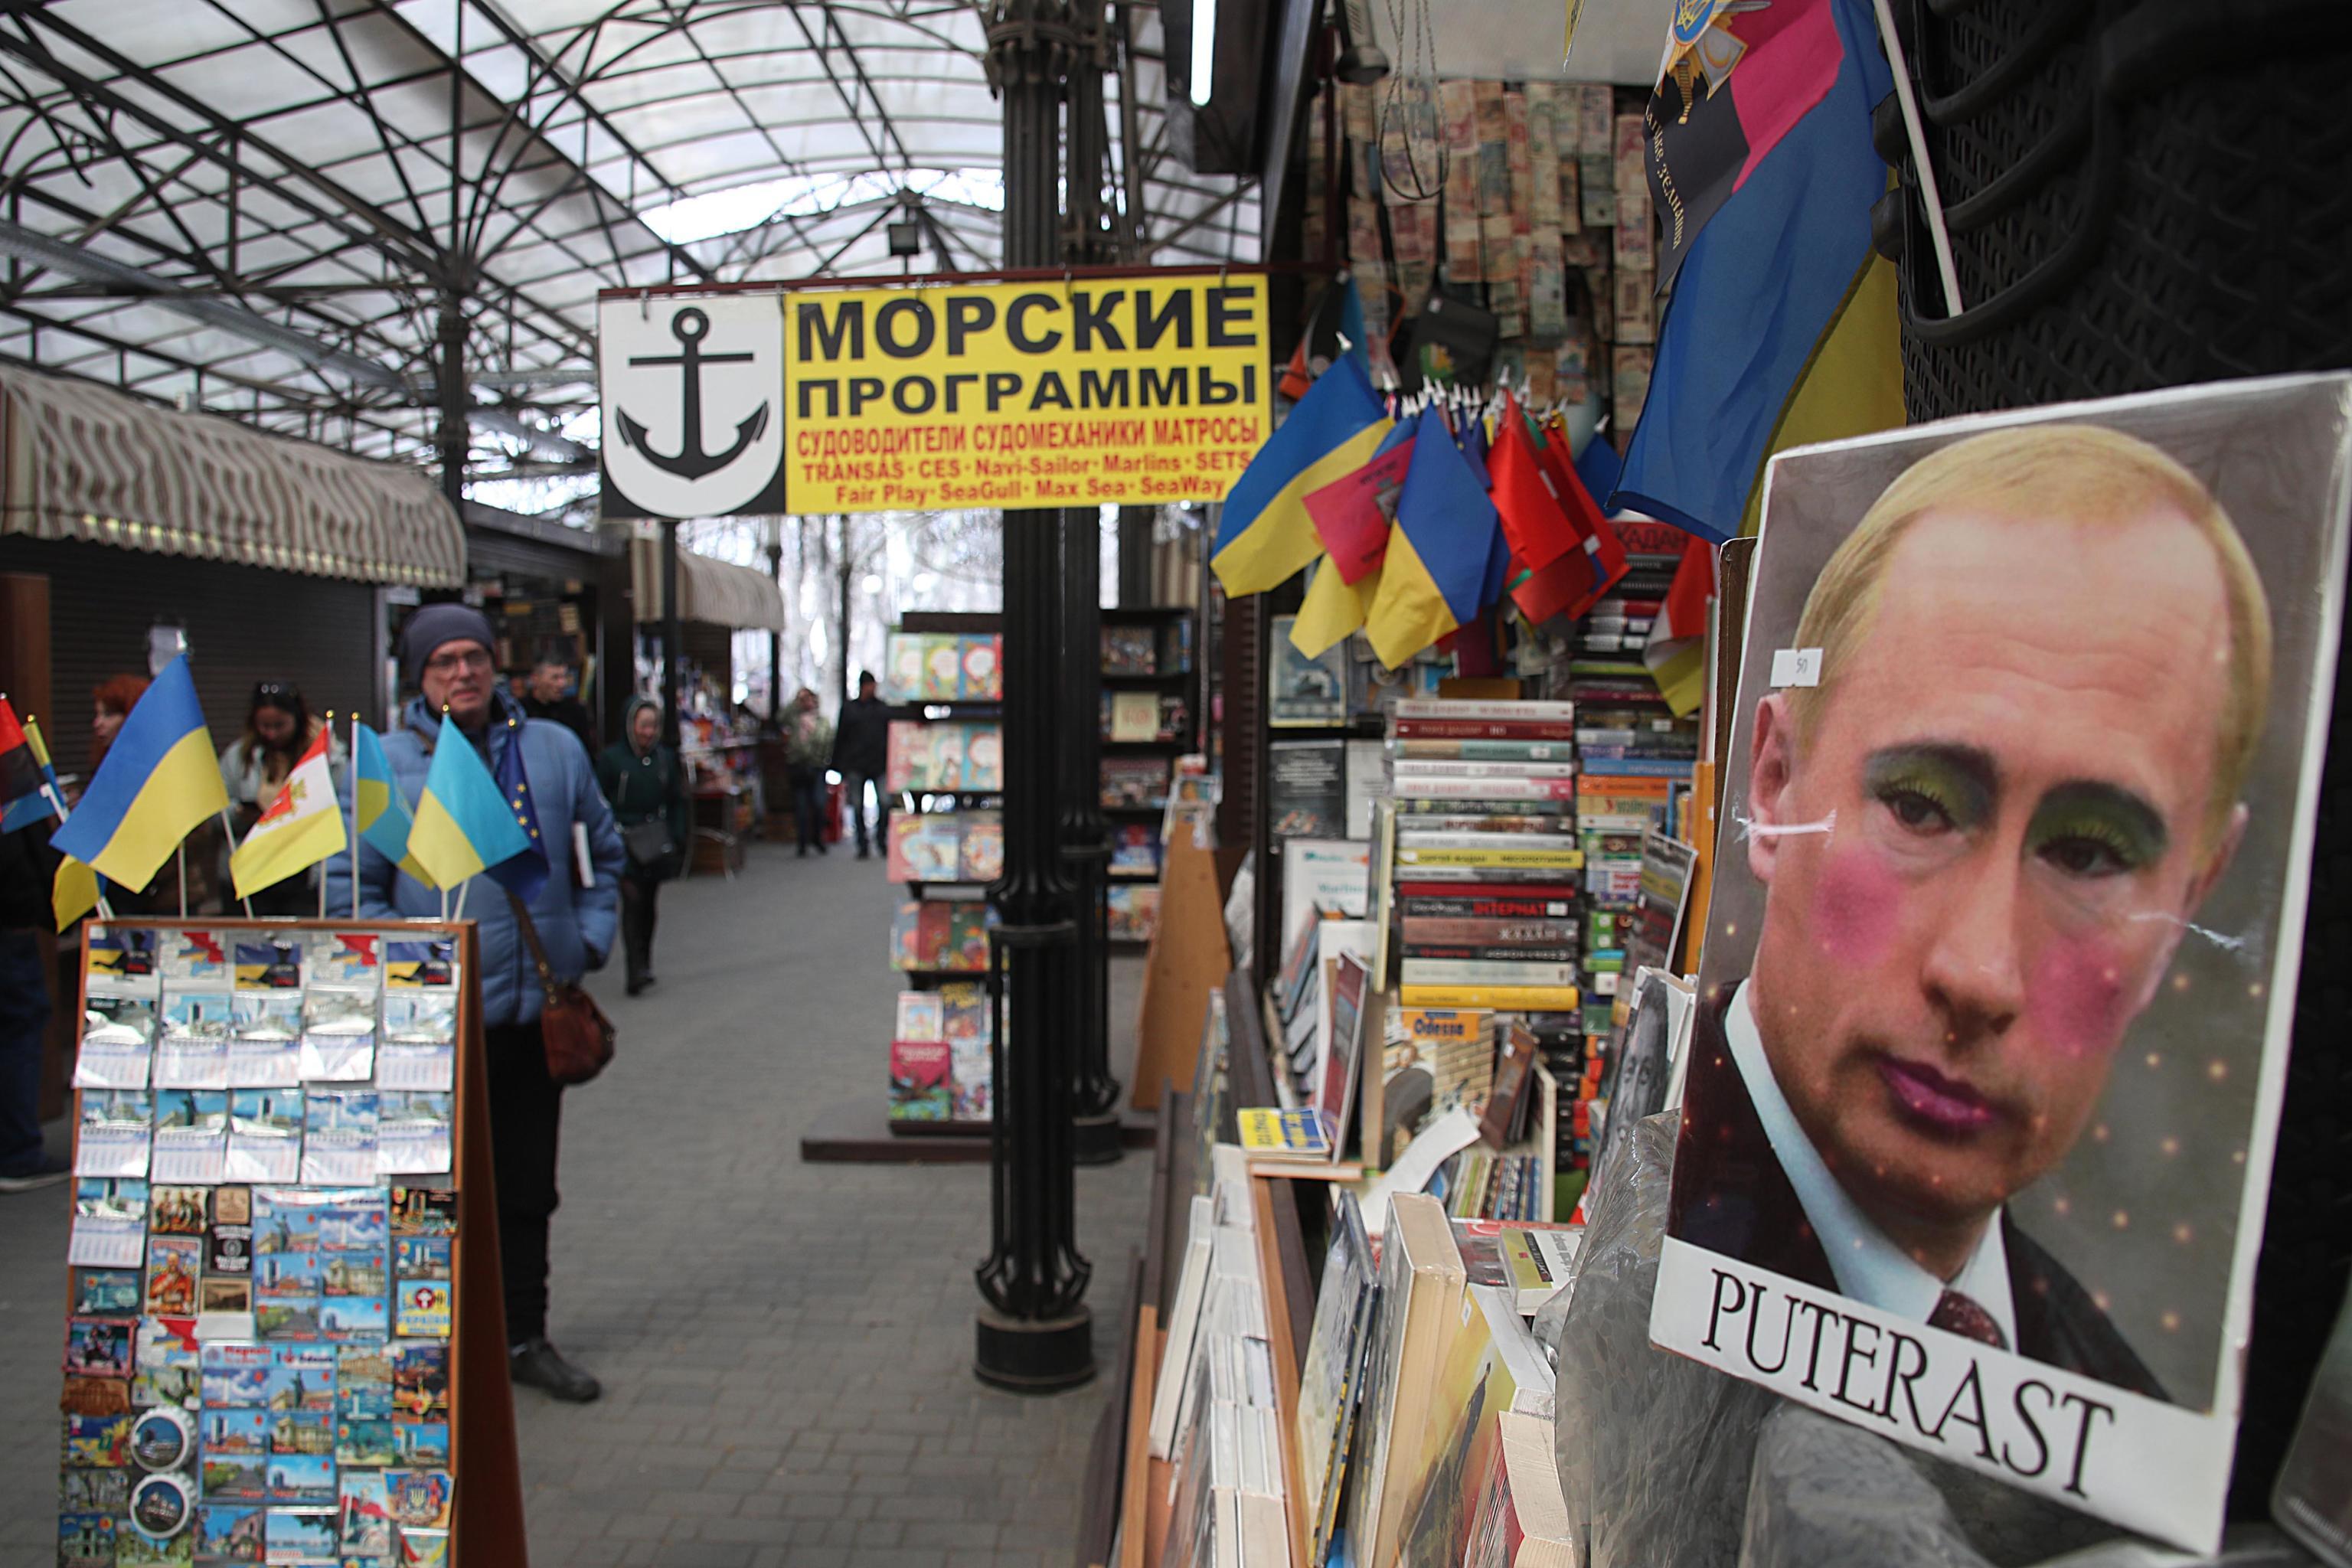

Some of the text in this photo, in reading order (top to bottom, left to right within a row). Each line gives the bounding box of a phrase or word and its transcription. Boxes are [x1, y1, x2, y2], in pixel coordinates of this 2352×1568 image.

[797, 286, 1256, 362] МОРСКИЕ
[798, 365, 1256, 418] ПРОГРАММЫ
[797, 416, 1259, 461] СУДОВОДИТЕЛИ СУДОМЕХАНИКИ МАТРОСЫ
[802, 449, 1253, 483] TRANSAS CES Navi-Sailor Marlins SETS
[835, 475, 1225, 508] Fair Play SeaGull Max Sea SeaWay
[1701, 1269, 2115, 1500] PUTERAST
